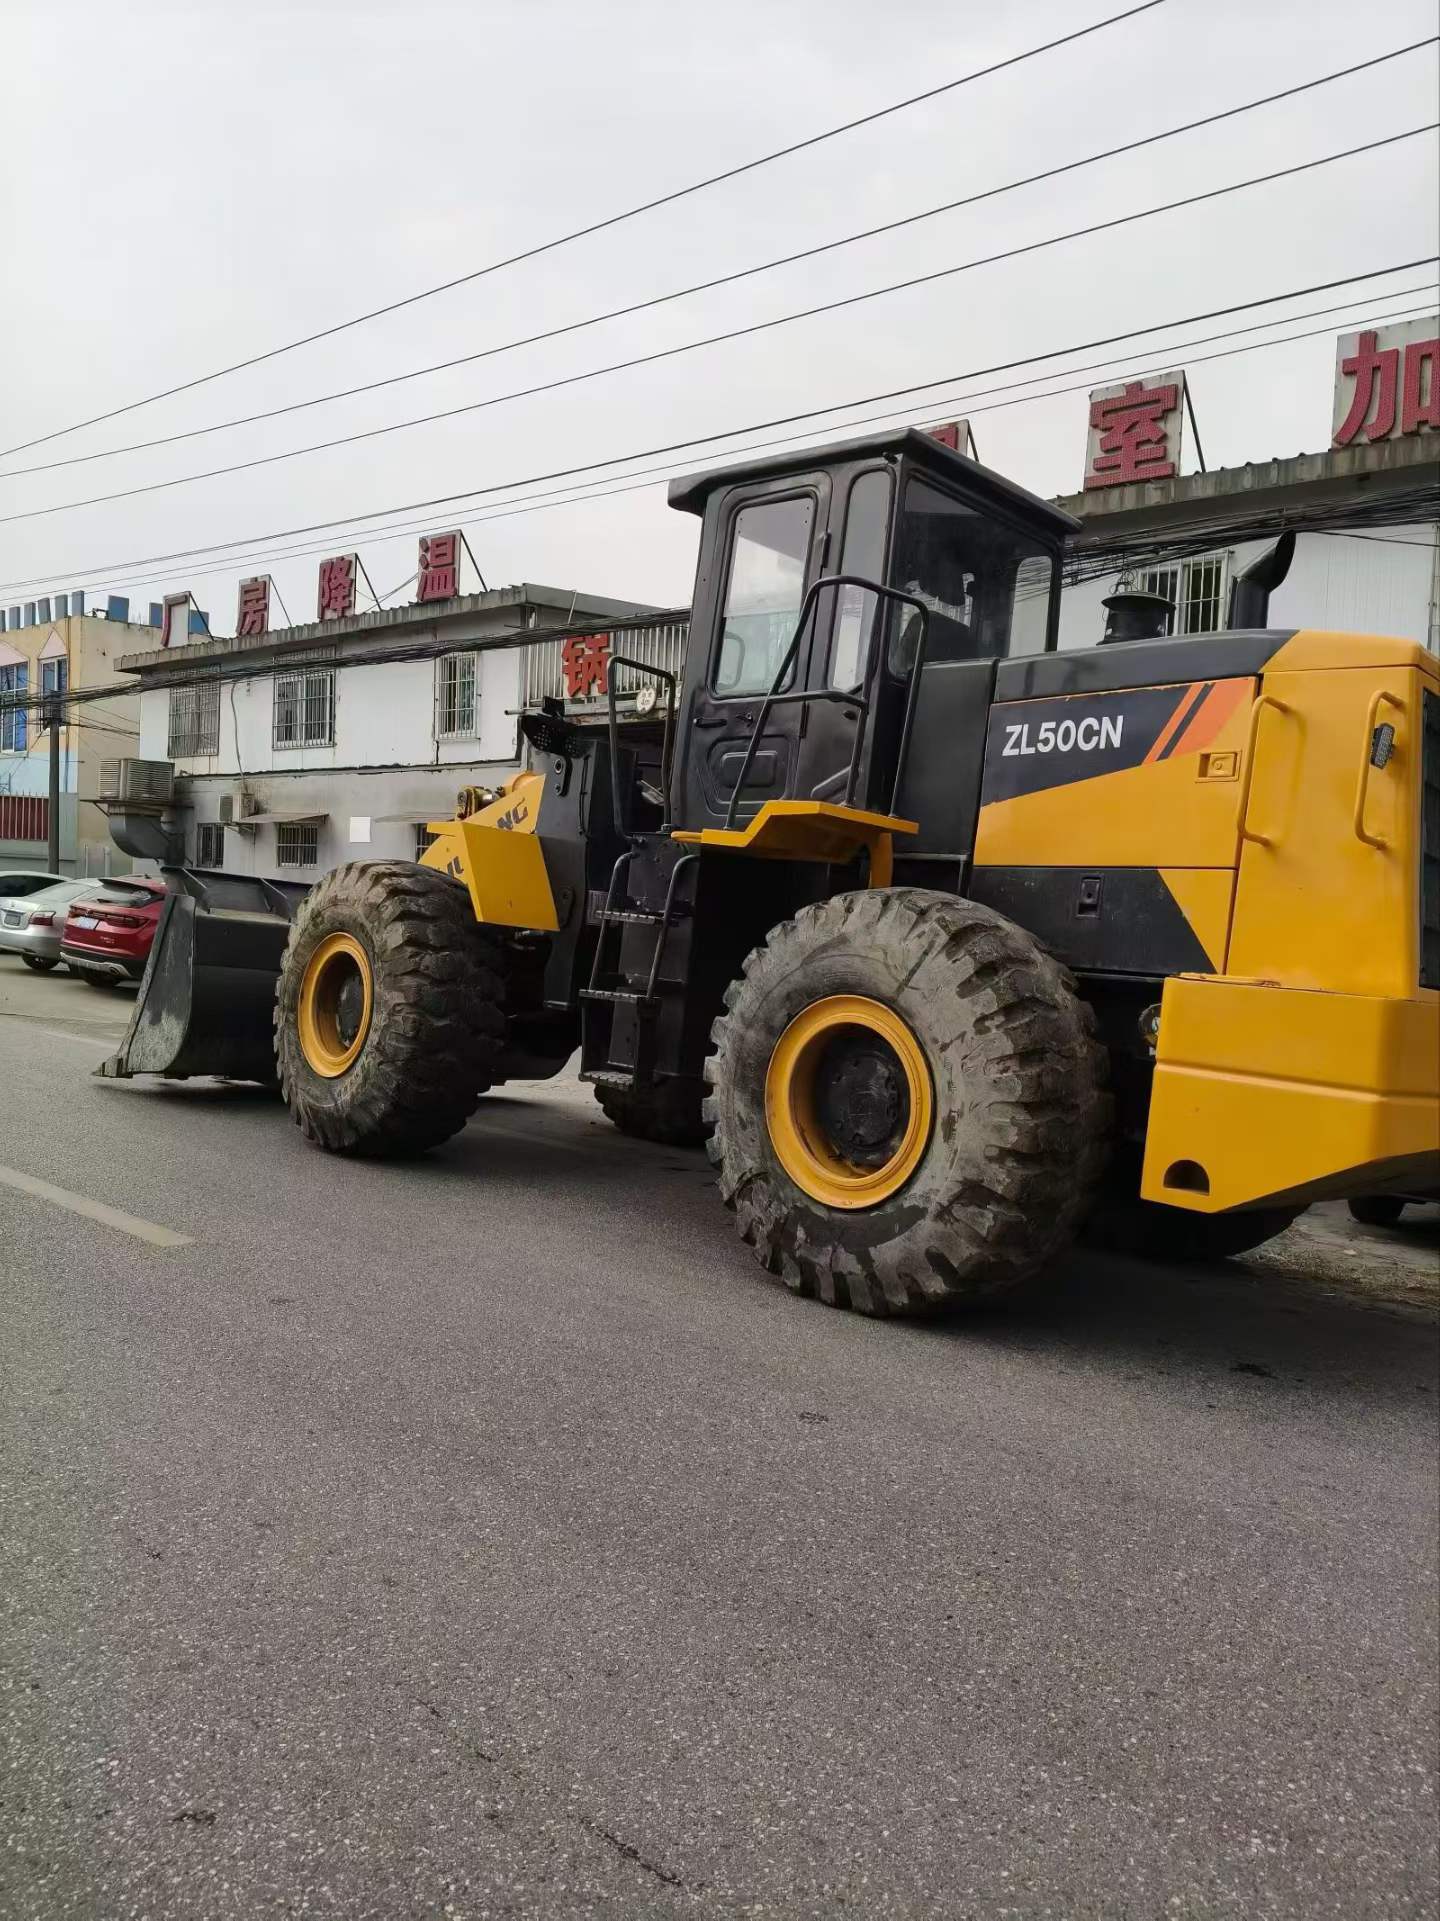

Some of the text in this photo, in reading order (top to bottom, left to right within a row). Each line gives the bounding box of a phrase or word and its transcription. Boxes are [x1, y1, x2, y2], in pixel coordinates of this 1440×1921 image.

[161, 532, 460, 648] 厂房降温
[1001, 715, 1124, 756] ZL50CN
